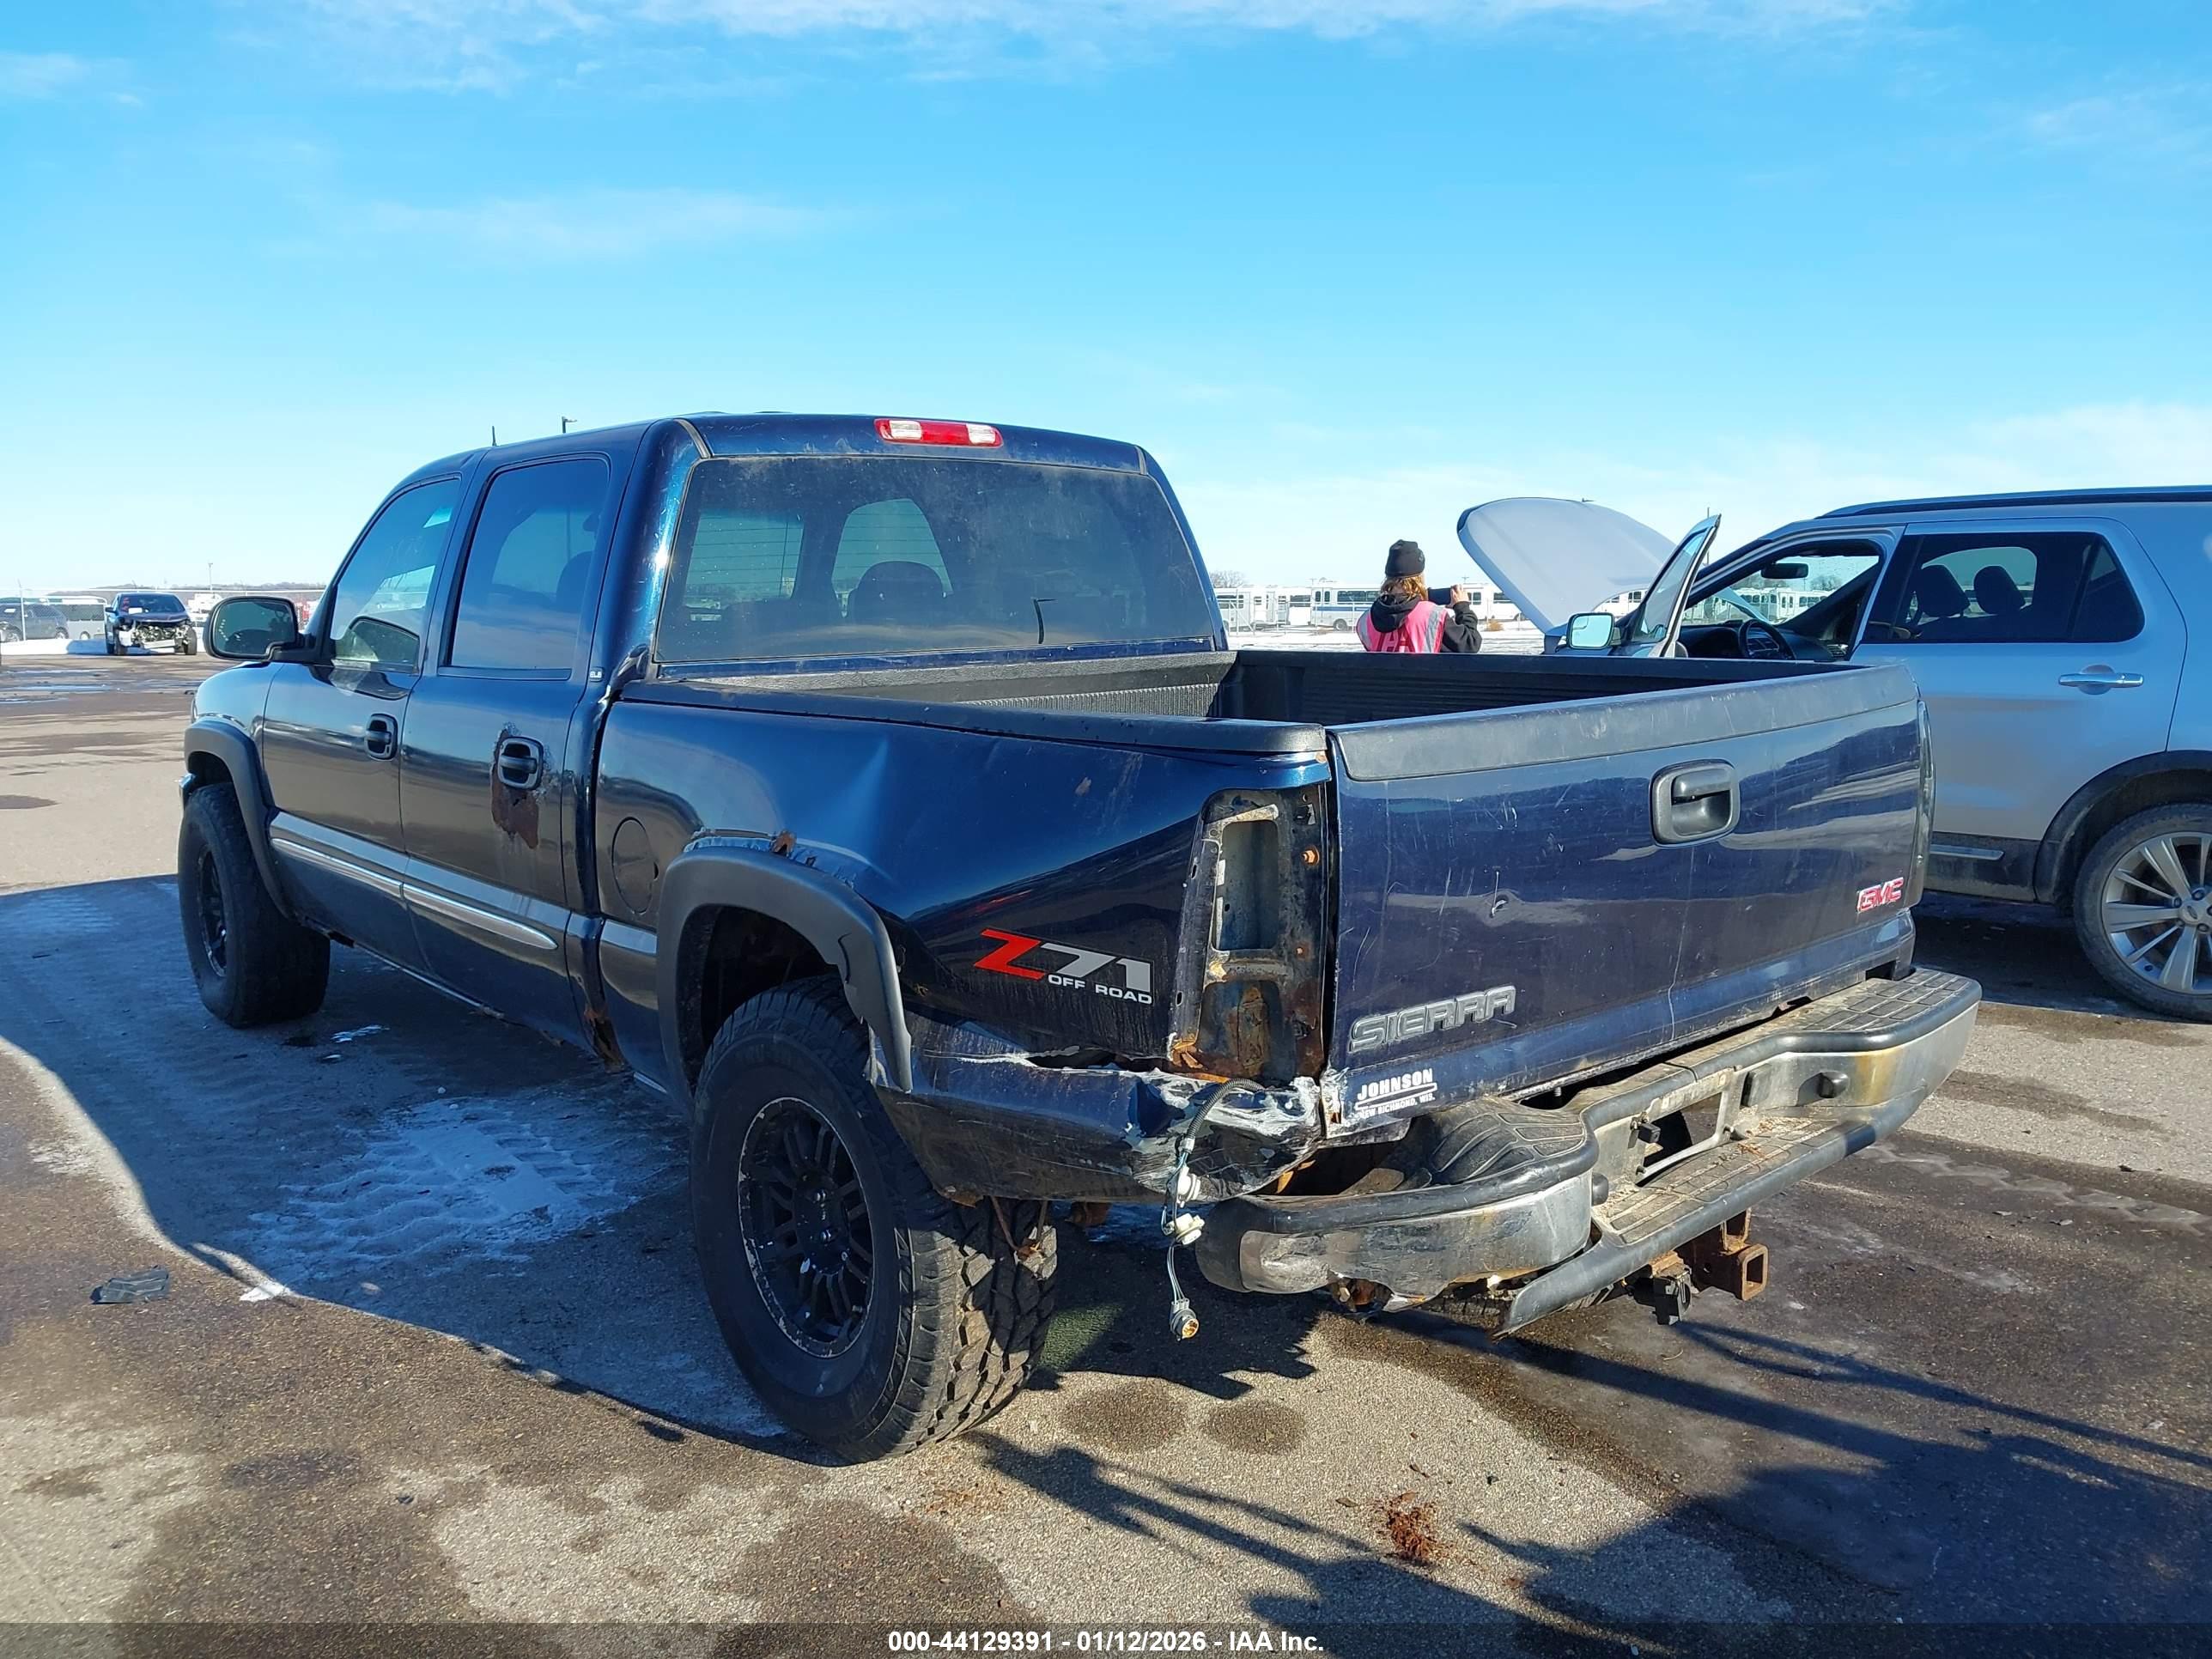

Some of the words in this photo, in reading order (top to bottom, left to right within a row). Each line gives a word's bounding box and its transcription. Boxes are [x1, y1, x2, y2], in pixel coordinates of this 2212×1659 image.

[1856, 877, 1904, 914] GMC
[974, 928, 1152, 993] Z71
[1048, 974, 1085, 989] OFF
[1095, 983, 1152, 1005] ROAD
[1347, 985, 1517, 1054] SIERRA
[1357, 1067, 1433, 1101] JOHNSON
[1357, 1107, 1376, 1120] NEW
[1377, 1097, 1418, 1115] RICHMOND,
[1419, 1091, 1436, 1103] WIS.
